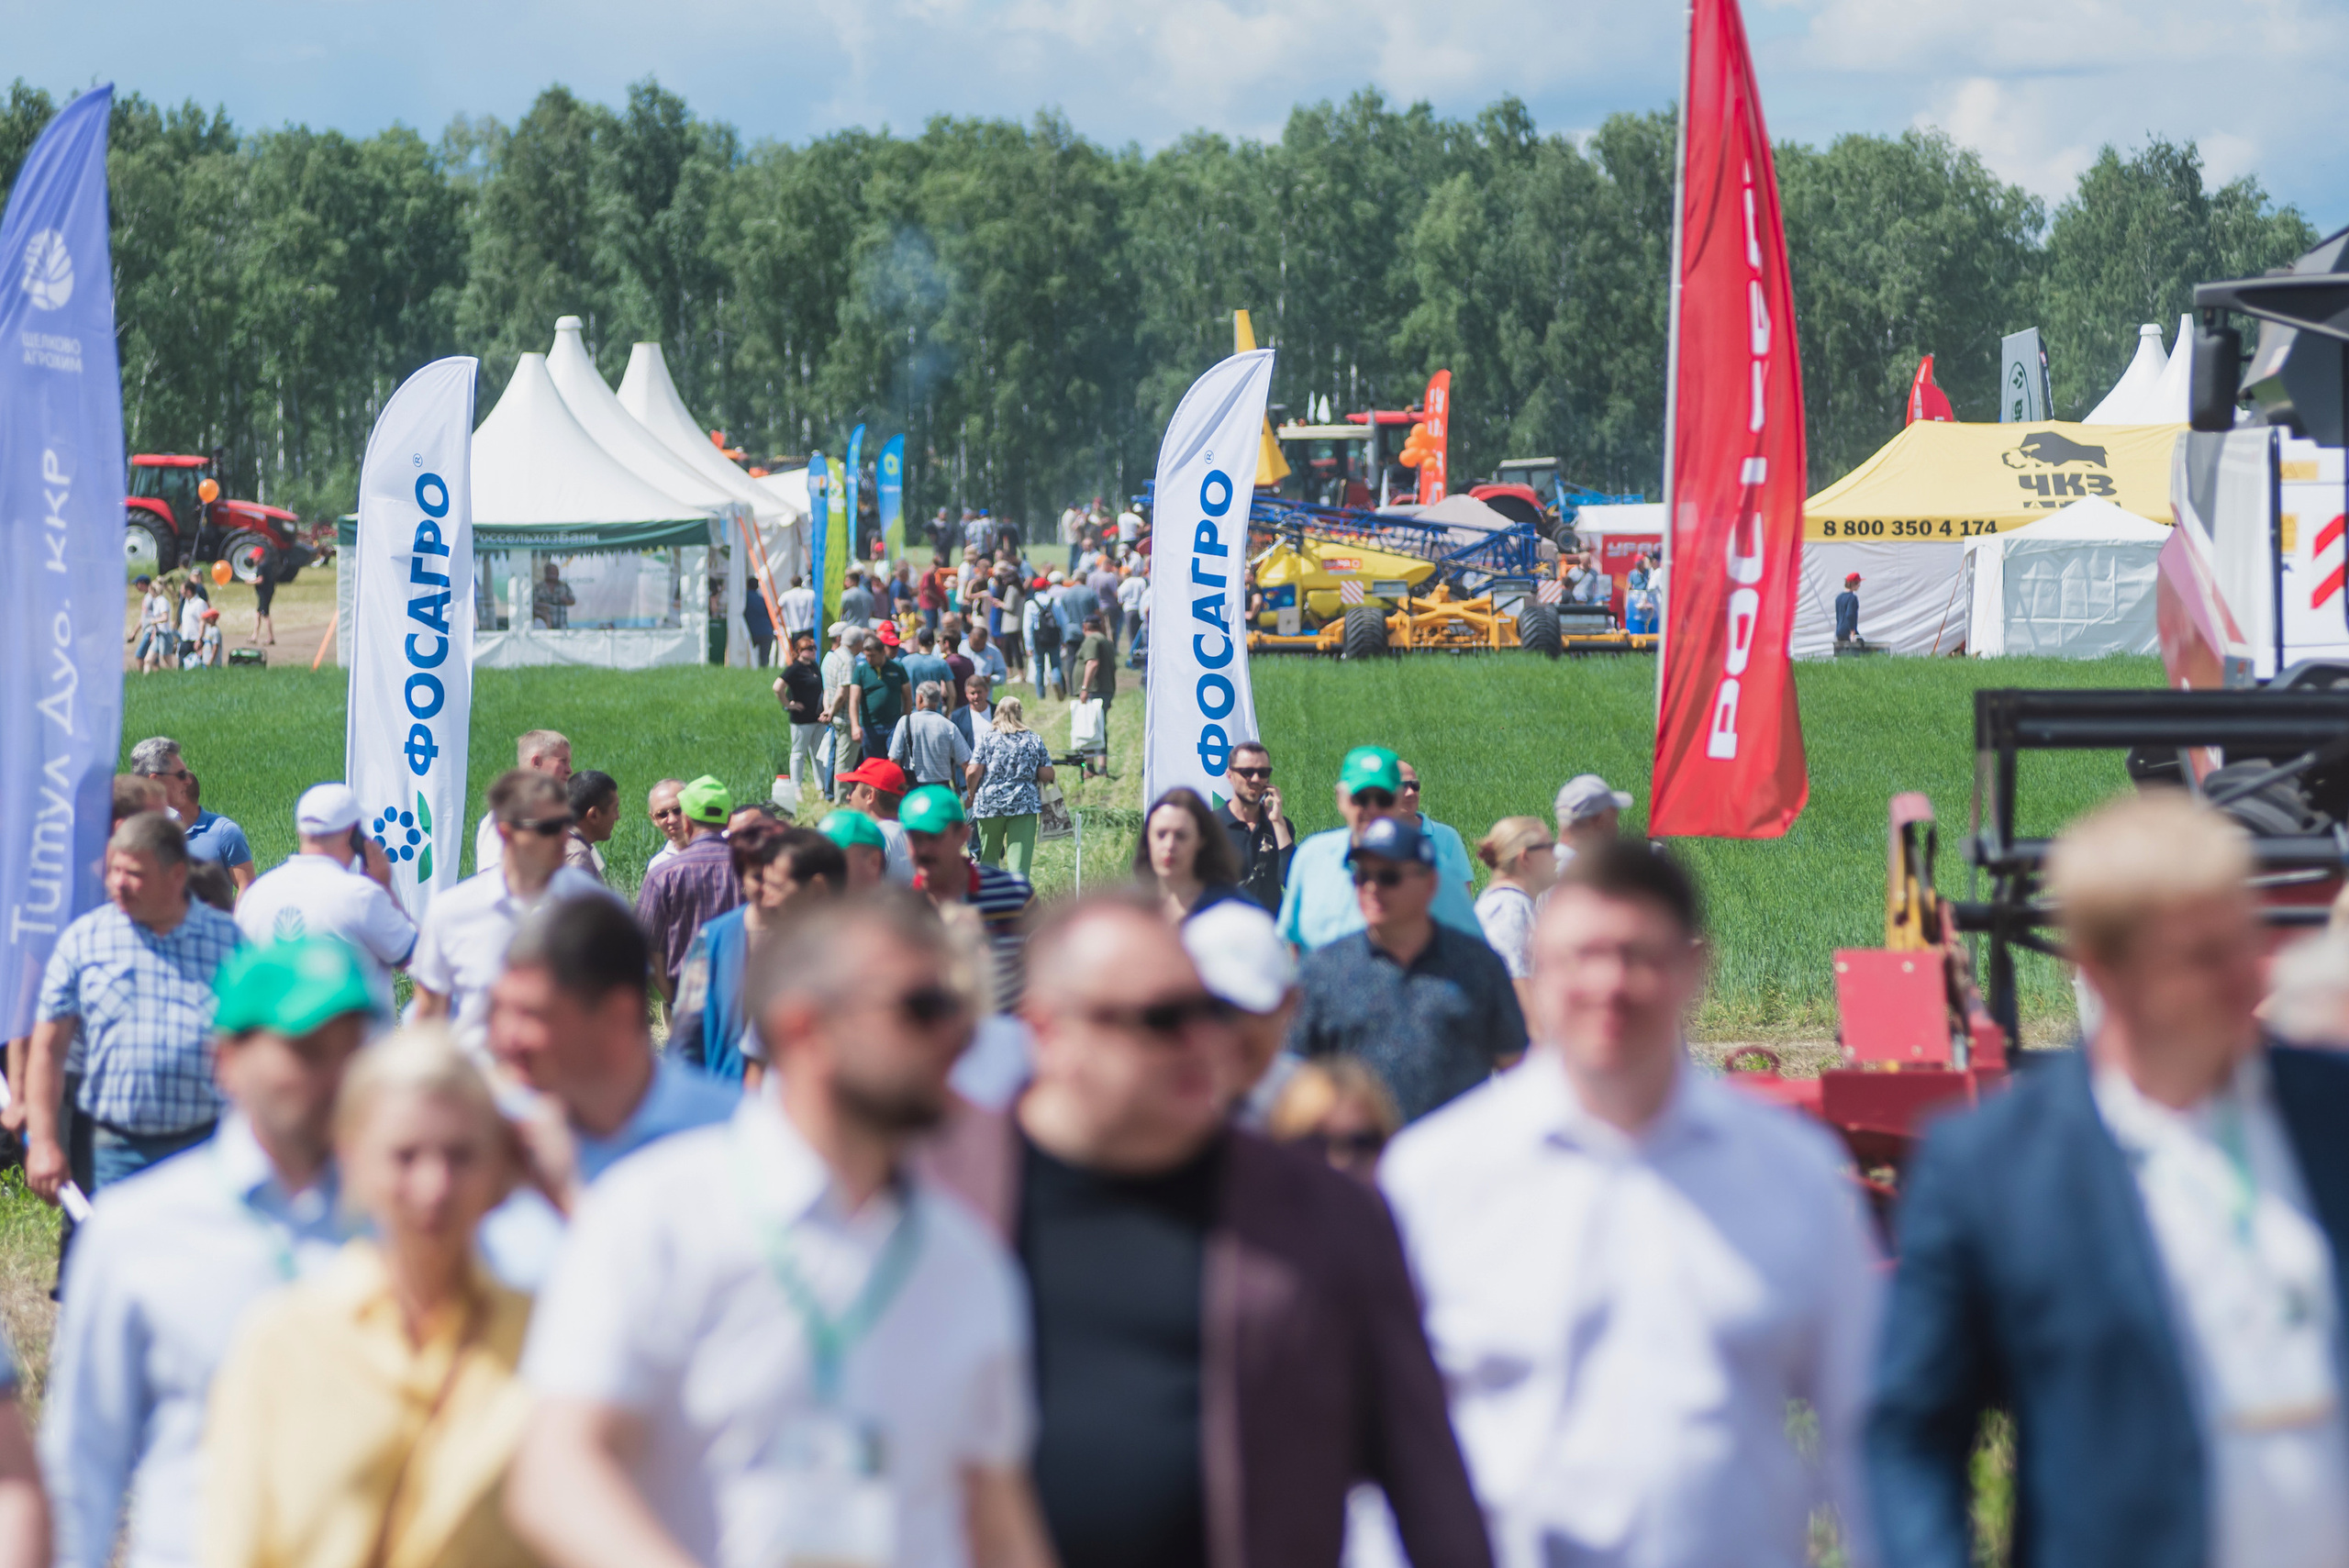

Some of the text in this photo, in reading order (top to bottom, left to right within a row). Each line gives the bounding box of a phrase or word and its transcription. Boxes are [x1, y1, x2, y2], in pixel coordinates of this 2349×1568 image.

[43, 449, 71, 573] ККР
[1823, 520, 1998, 536] 8 800 350 4 174
[2018, 473, 2118, 496] ЧКЗ
[404, 473, 451, 776] ФОСАГРО
[1192, 469, 1235, 777] ФОСАГРО
